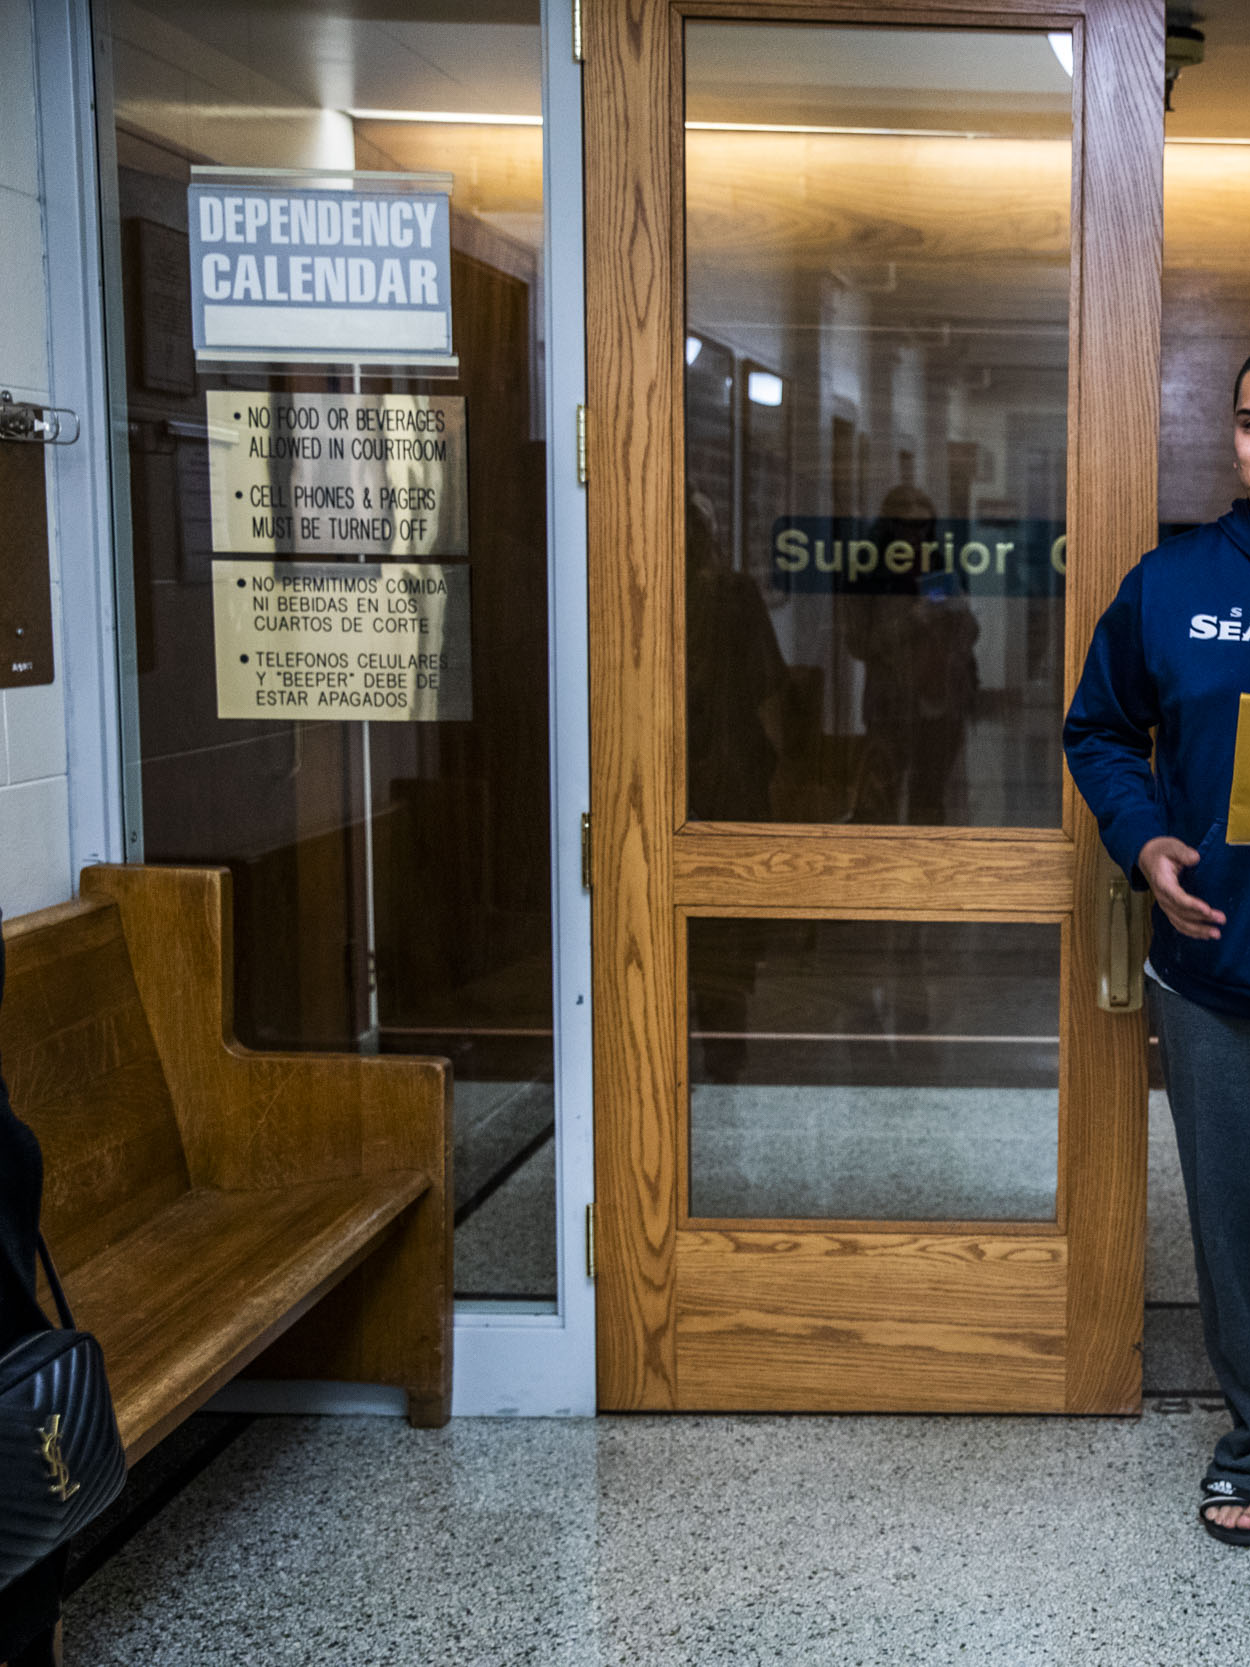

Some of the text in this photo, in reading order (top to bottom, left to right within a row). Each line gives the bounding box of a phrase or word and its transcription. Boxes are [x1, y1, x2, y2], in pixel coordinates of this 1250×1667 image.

[199, 196, 438, 249] DEPENDENCY
[201, 252, 439, 305] CALENDAR
[248, 406, 446, 432] NO FOOD OR BEVERAGES
[249, 436, 447, 462] ALLOWED IN COURTROOM
[250, 485, 436, 511] CELL PHONES & PAGERS
[252, 516, 428, 541] MUST BE TURNED OFF
[775, 529, 1015, 583] Superior
[252, 576, 447, 595] NO PERMITIMOS COMIDA
[253, 596, 418, 614] NI BEBIDAS EN LOS
[253, 615, 430, 634] CUARTOS DE CORTE
[256, 651, 449, 670] TELEFONOS CELULARES
[256, 671, 439, 690] Y "BEEPER" DEBE DE
[256, 690, 409, 708] ESTAR APAGADOS
